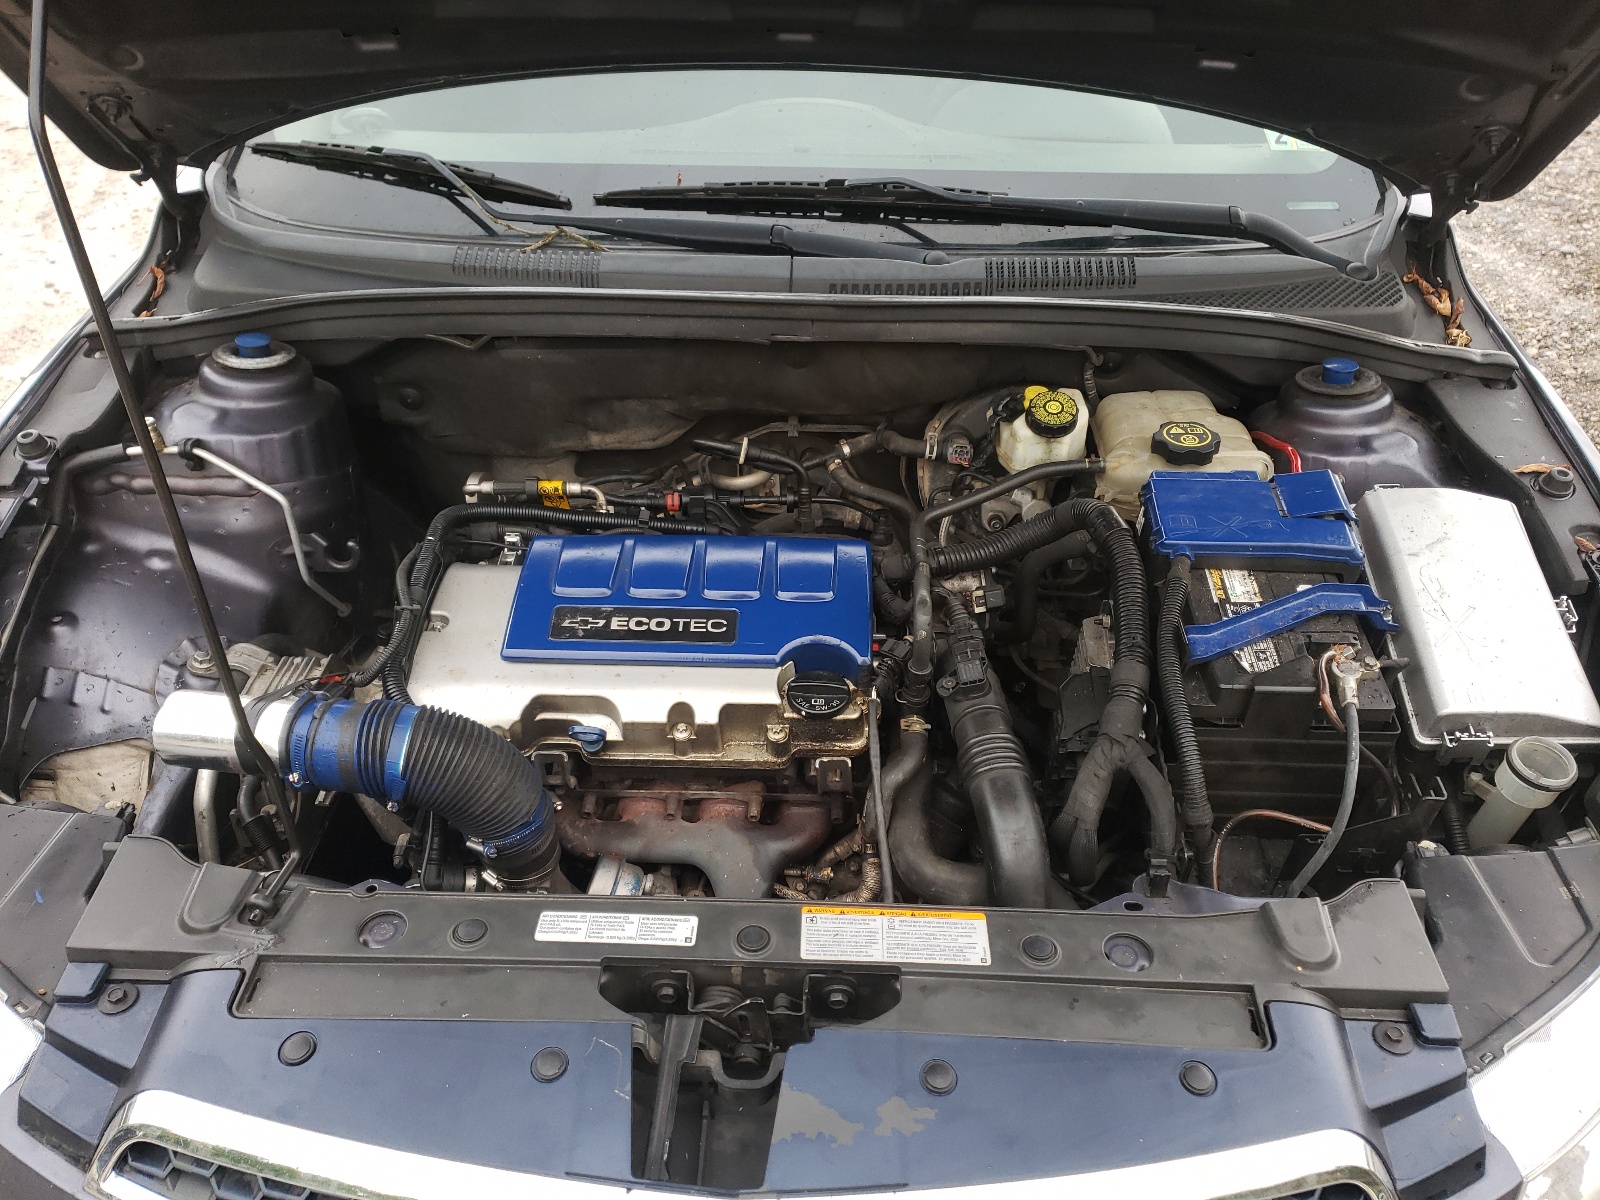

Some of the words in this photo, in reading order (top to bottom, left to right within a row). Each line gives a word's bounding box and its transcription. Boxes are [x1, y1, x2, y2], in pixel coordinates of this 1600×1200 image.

[610, 617, 727, 633] ECOTEC
[796, 697, 810, 709] SAE
[815, 699, 841, 711] 5W-30
